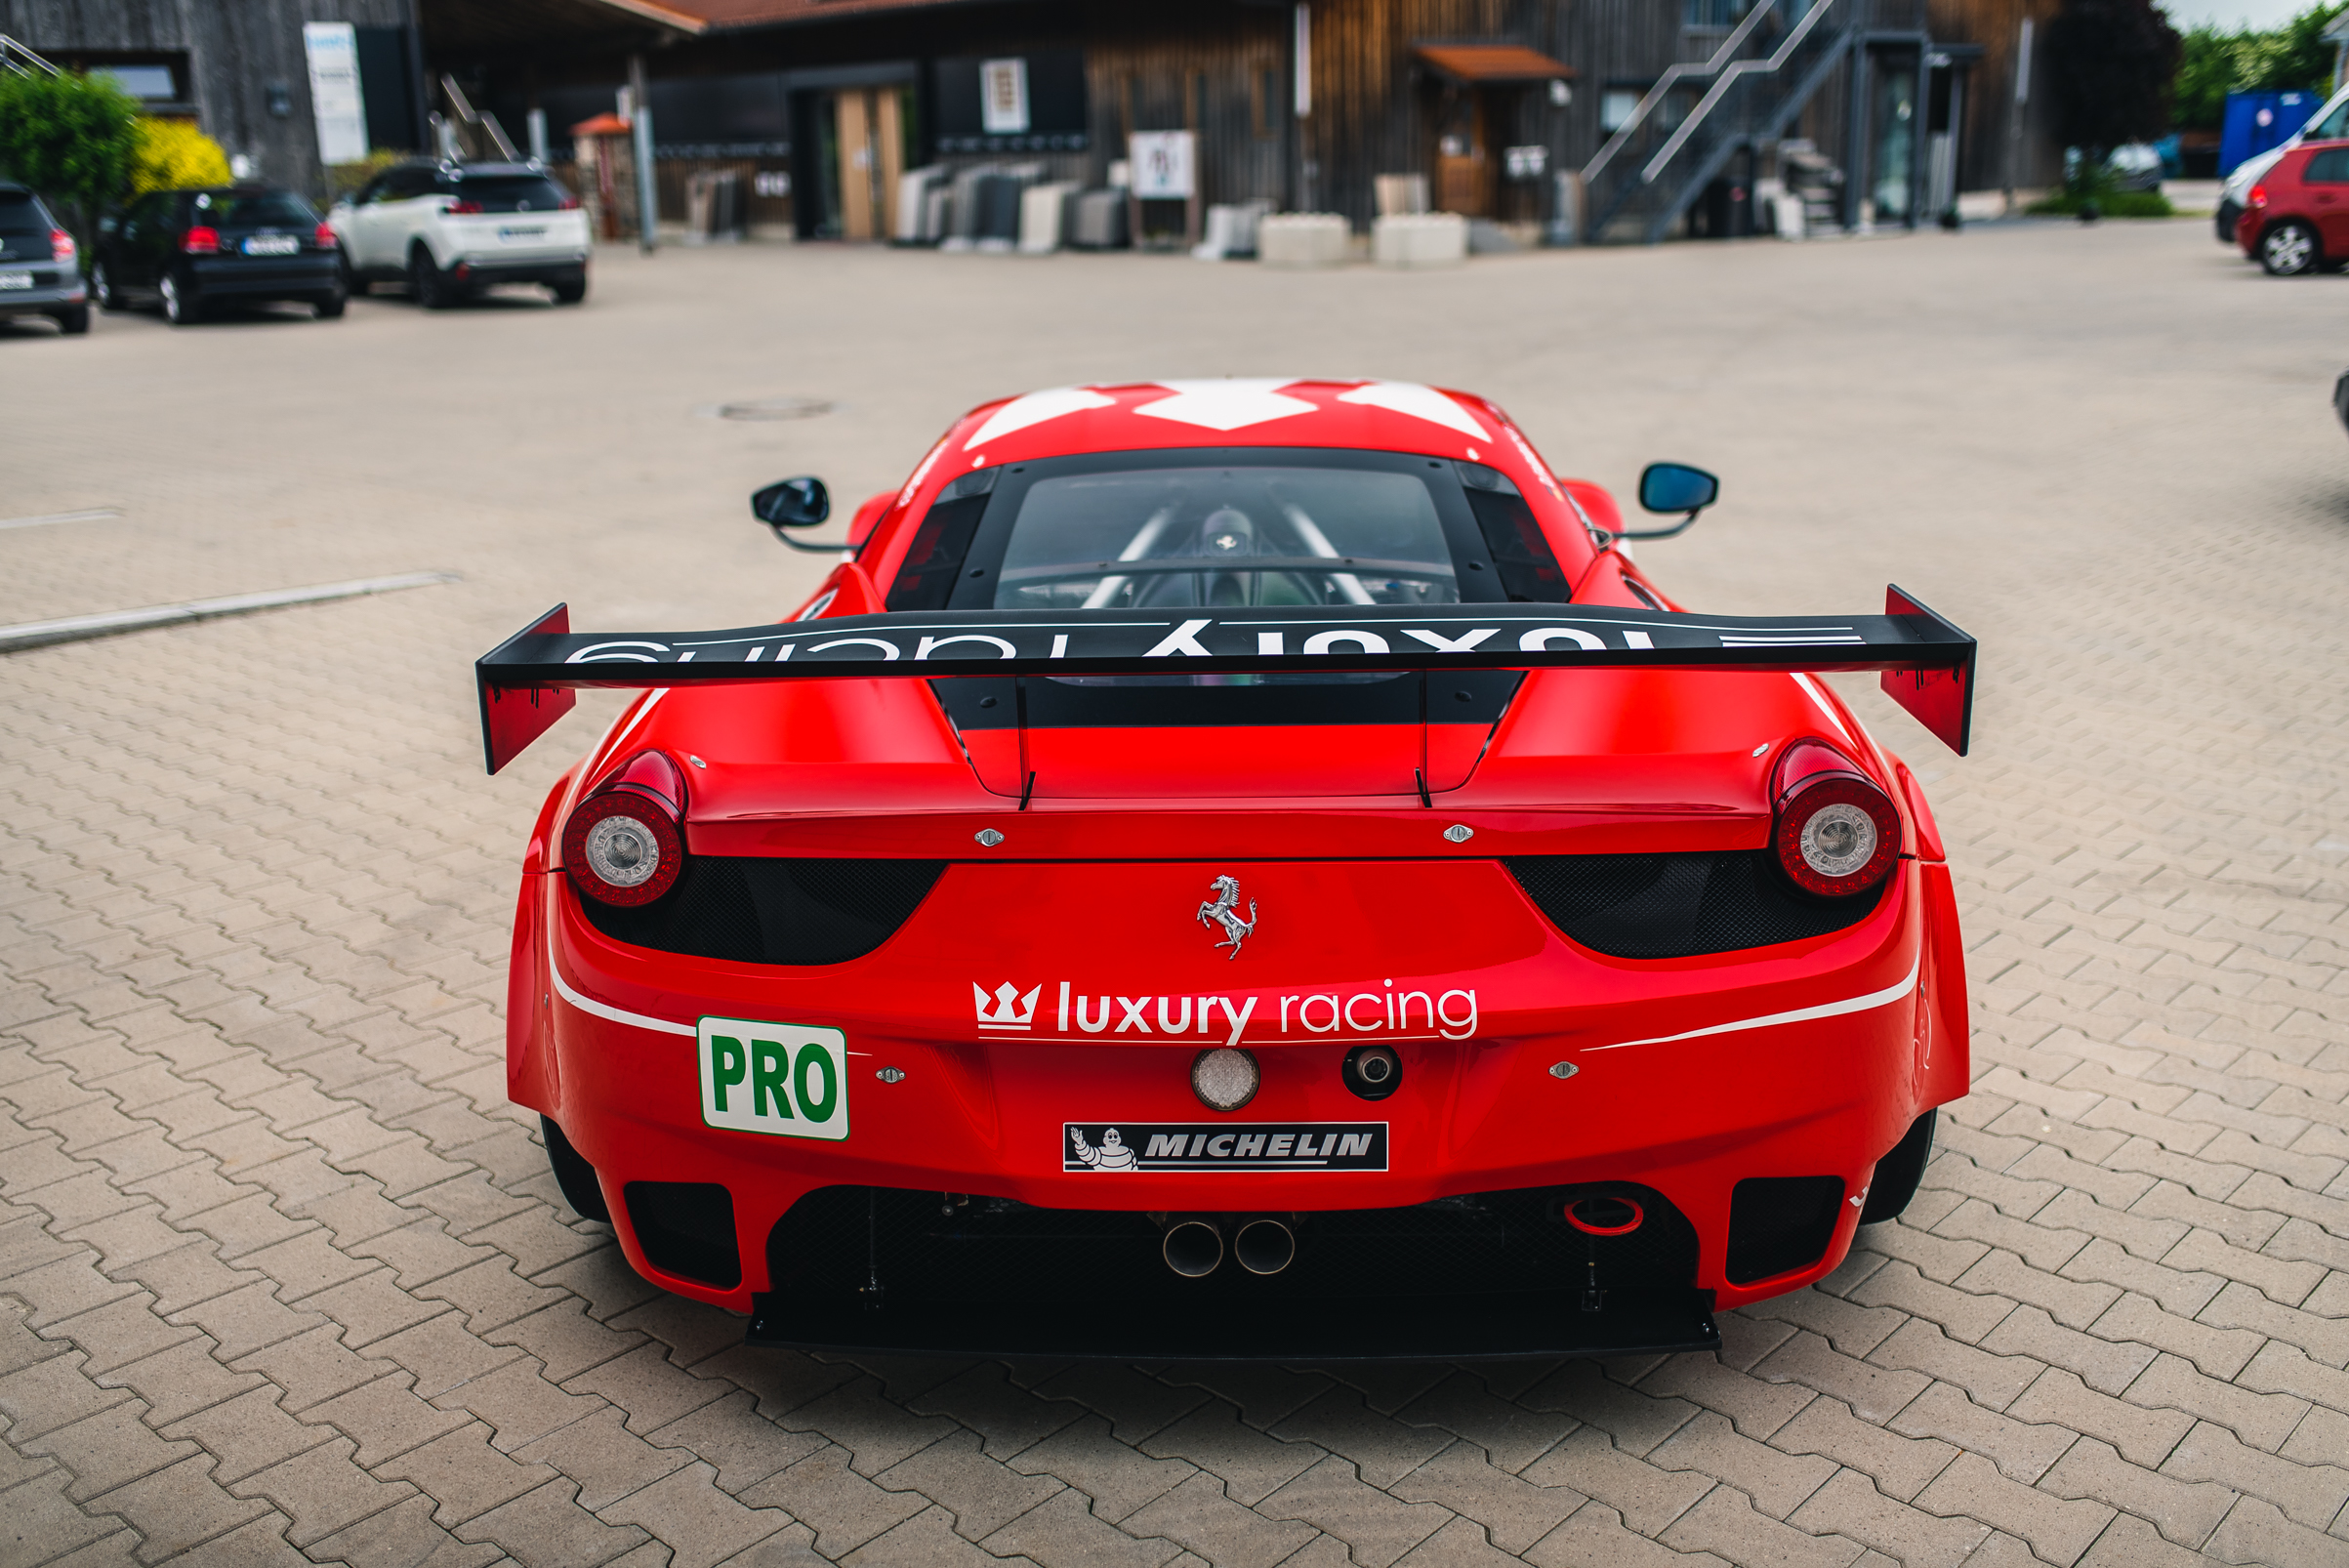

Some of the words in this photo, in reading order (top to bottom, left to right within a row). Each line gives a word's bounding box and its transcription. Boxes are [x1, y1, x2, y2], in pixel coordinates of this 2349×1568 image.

[1057, 981, 1258, 1047] luxury
[1280, 978, 1479, 1040] racing
[711, 1035, 838, 1124] PRO
[1144, 1134, 1374, 1158] MICHELIN
